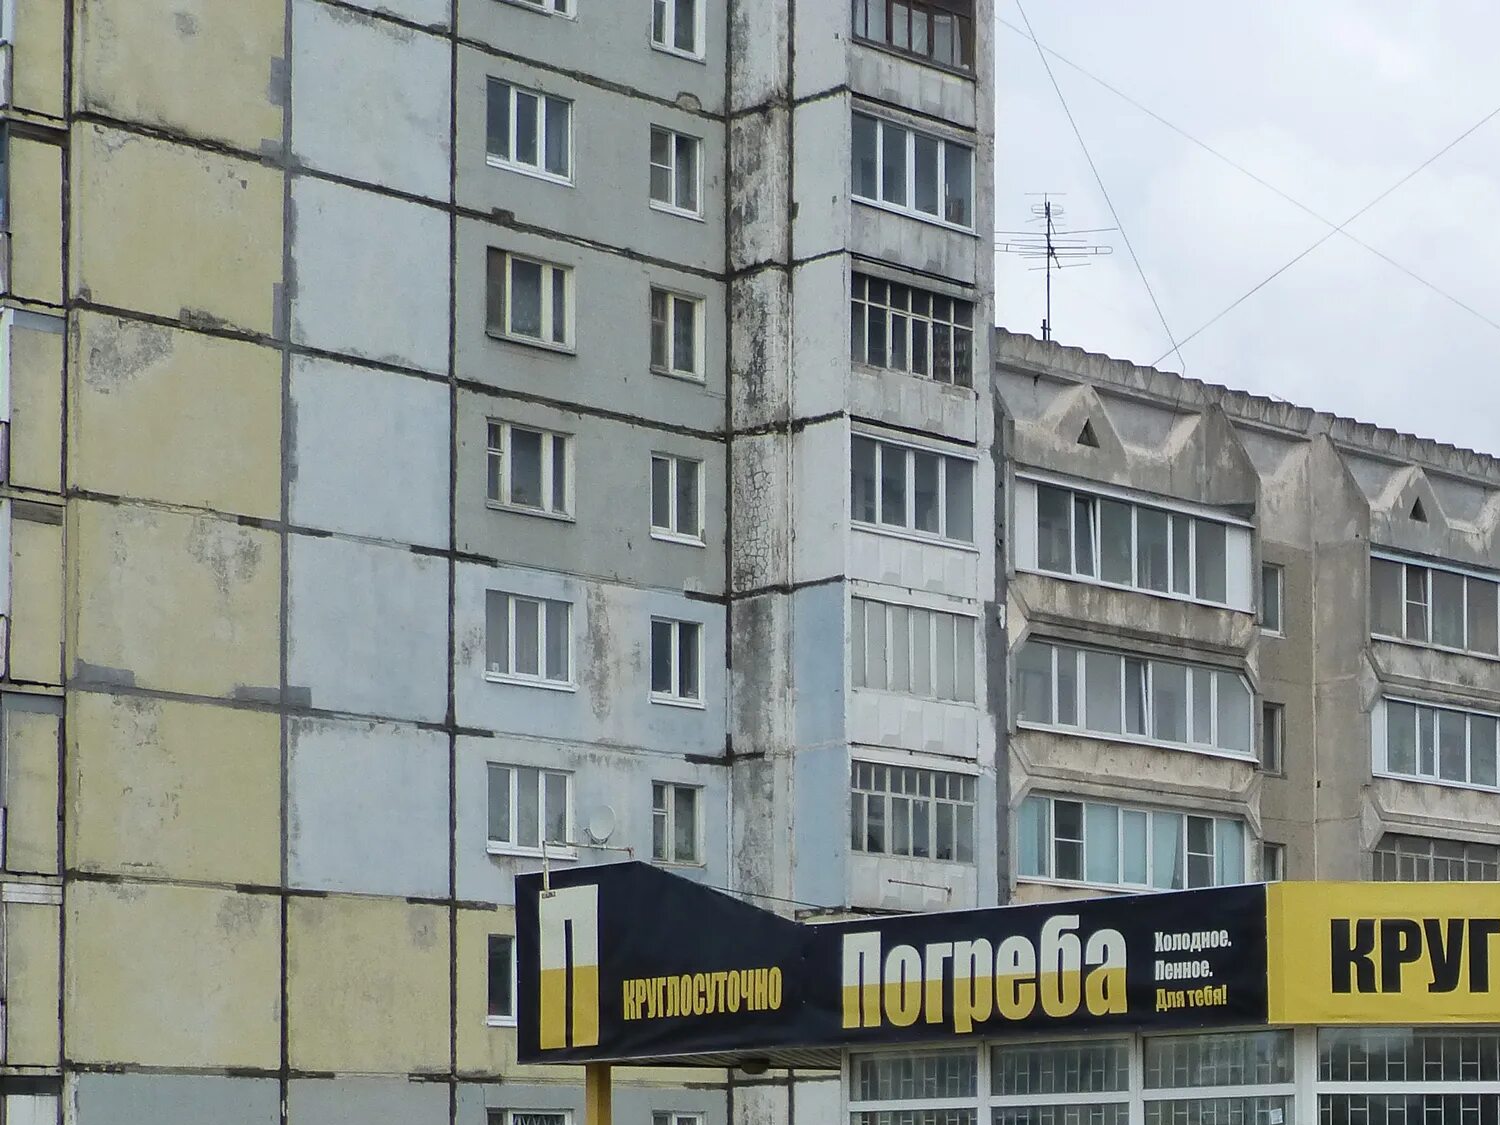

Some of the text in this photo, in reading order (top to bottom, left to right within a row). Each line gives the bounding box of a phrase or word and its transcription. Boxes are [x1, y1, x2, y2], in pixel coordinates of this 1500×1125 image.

[1154, 930, 1232, 952] Холодное.
[539, 884, 599, 1049] П
[842, 914, 1128, 1034] Погреба
[1155, 960, 1213, 980] Пенное.
[623, 966, 782, 1021] КРУГЛОСУТОЧНО
[1156, 984, 1227, 1012] Для тебя!
